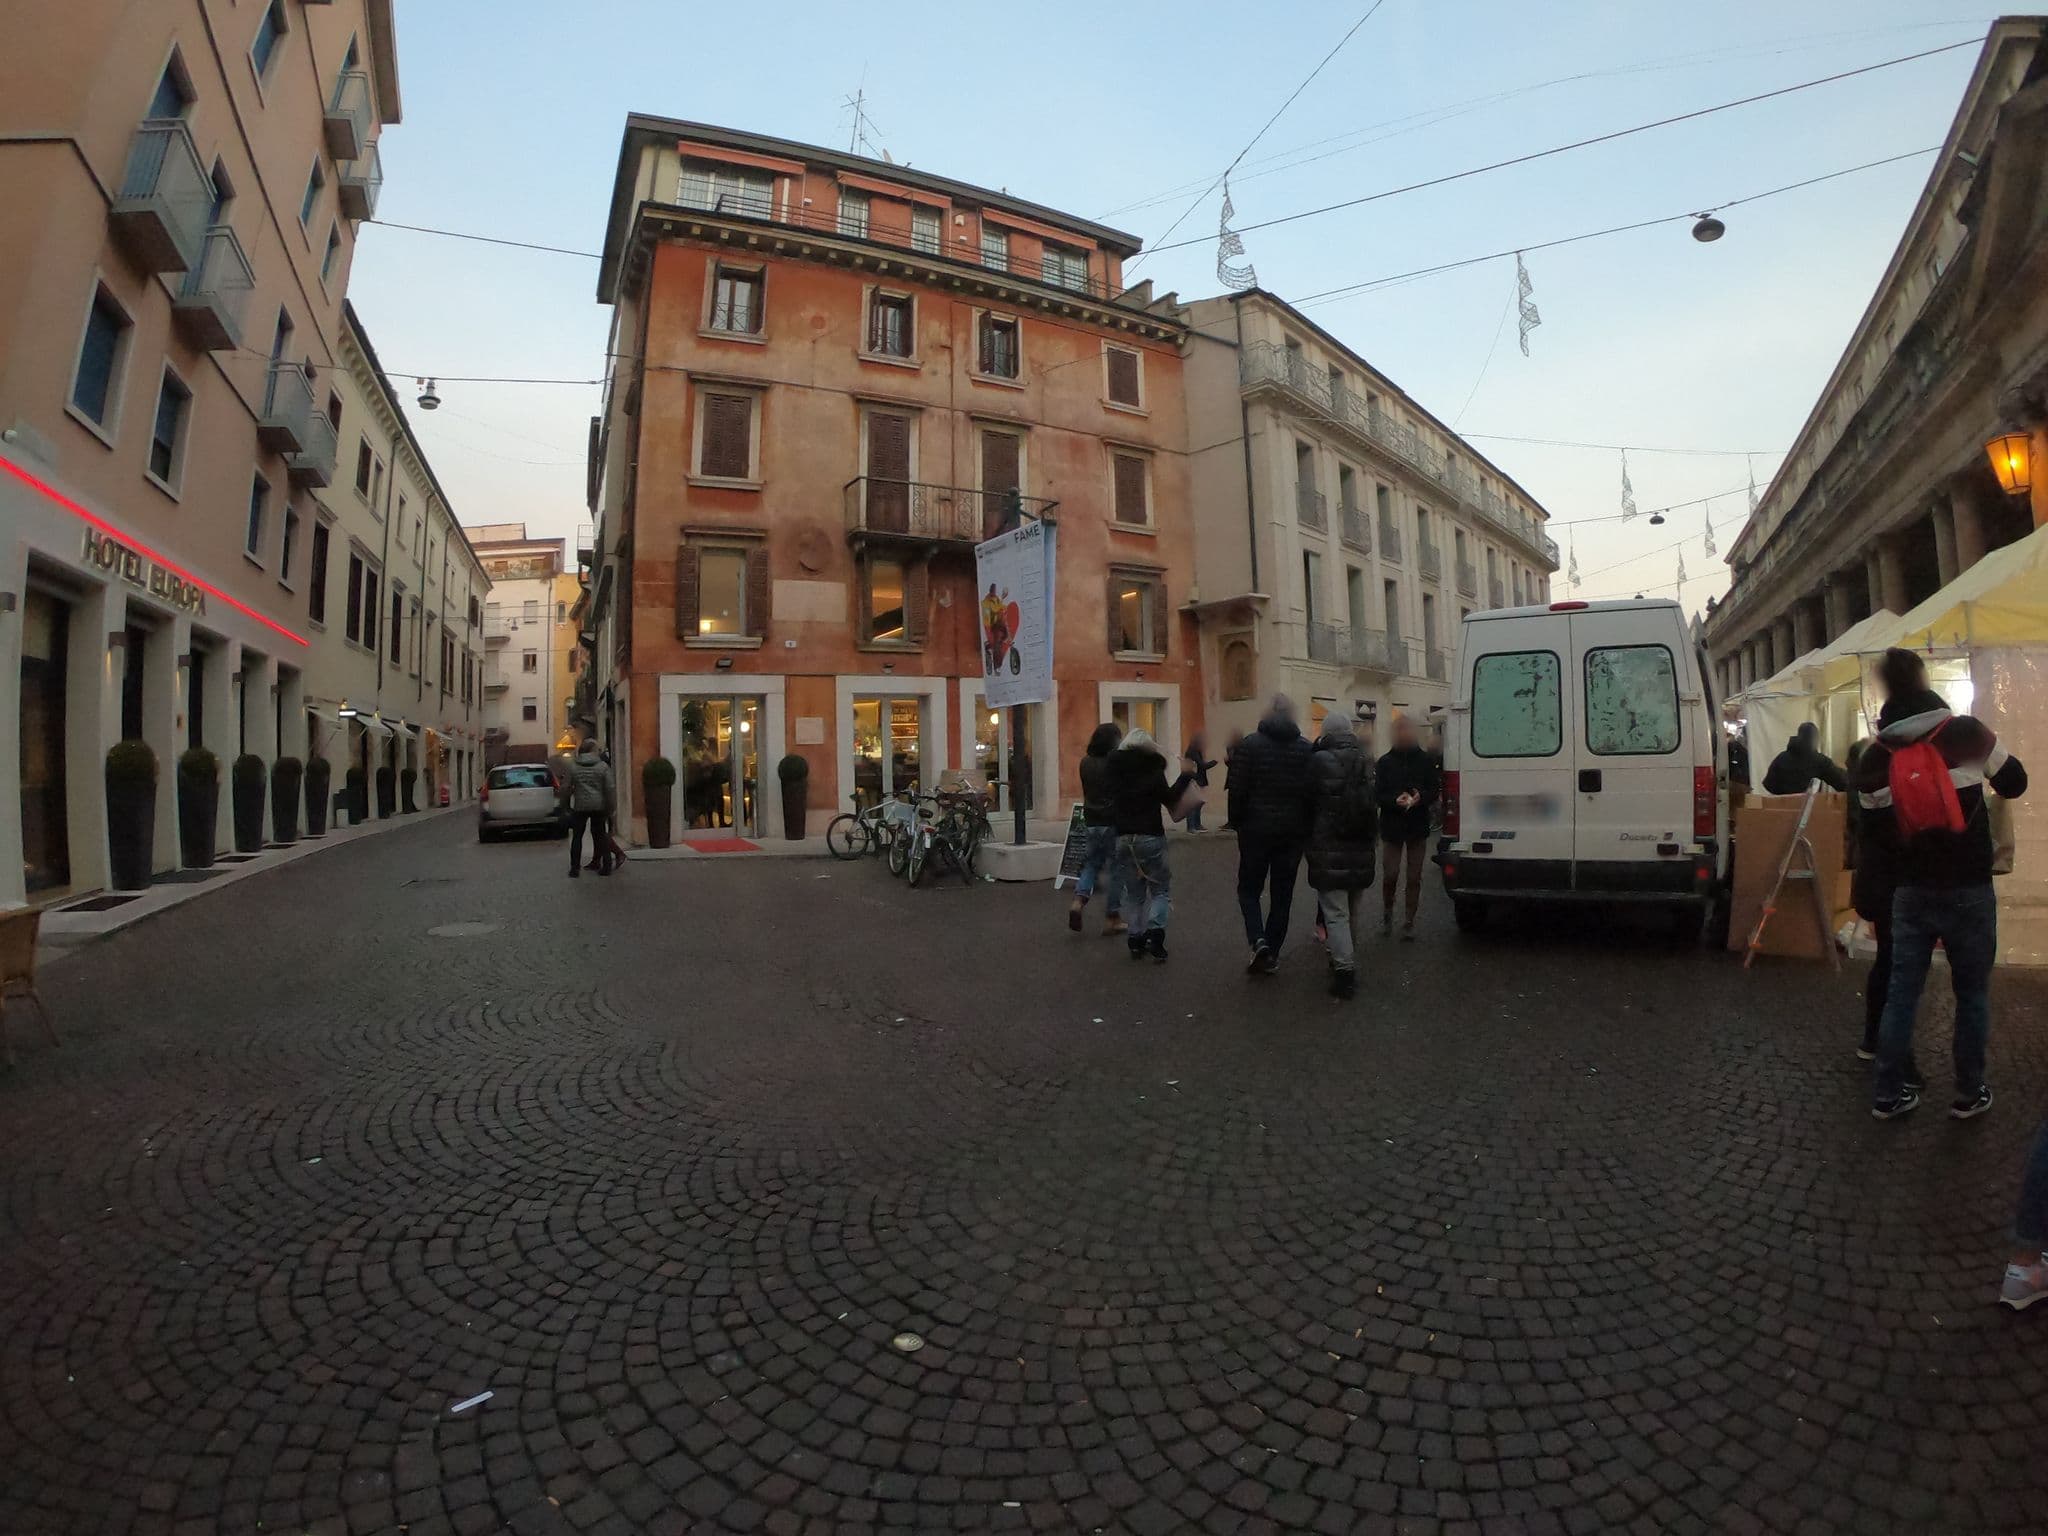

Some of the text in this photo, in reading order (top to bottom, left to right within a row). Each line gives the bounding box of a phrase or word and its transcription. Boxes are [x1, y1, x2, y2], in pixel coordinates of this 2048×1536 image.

[1014, 524, 1040, 544] FAME
[81, 526, 207, 617] HOTEL EUROPA
